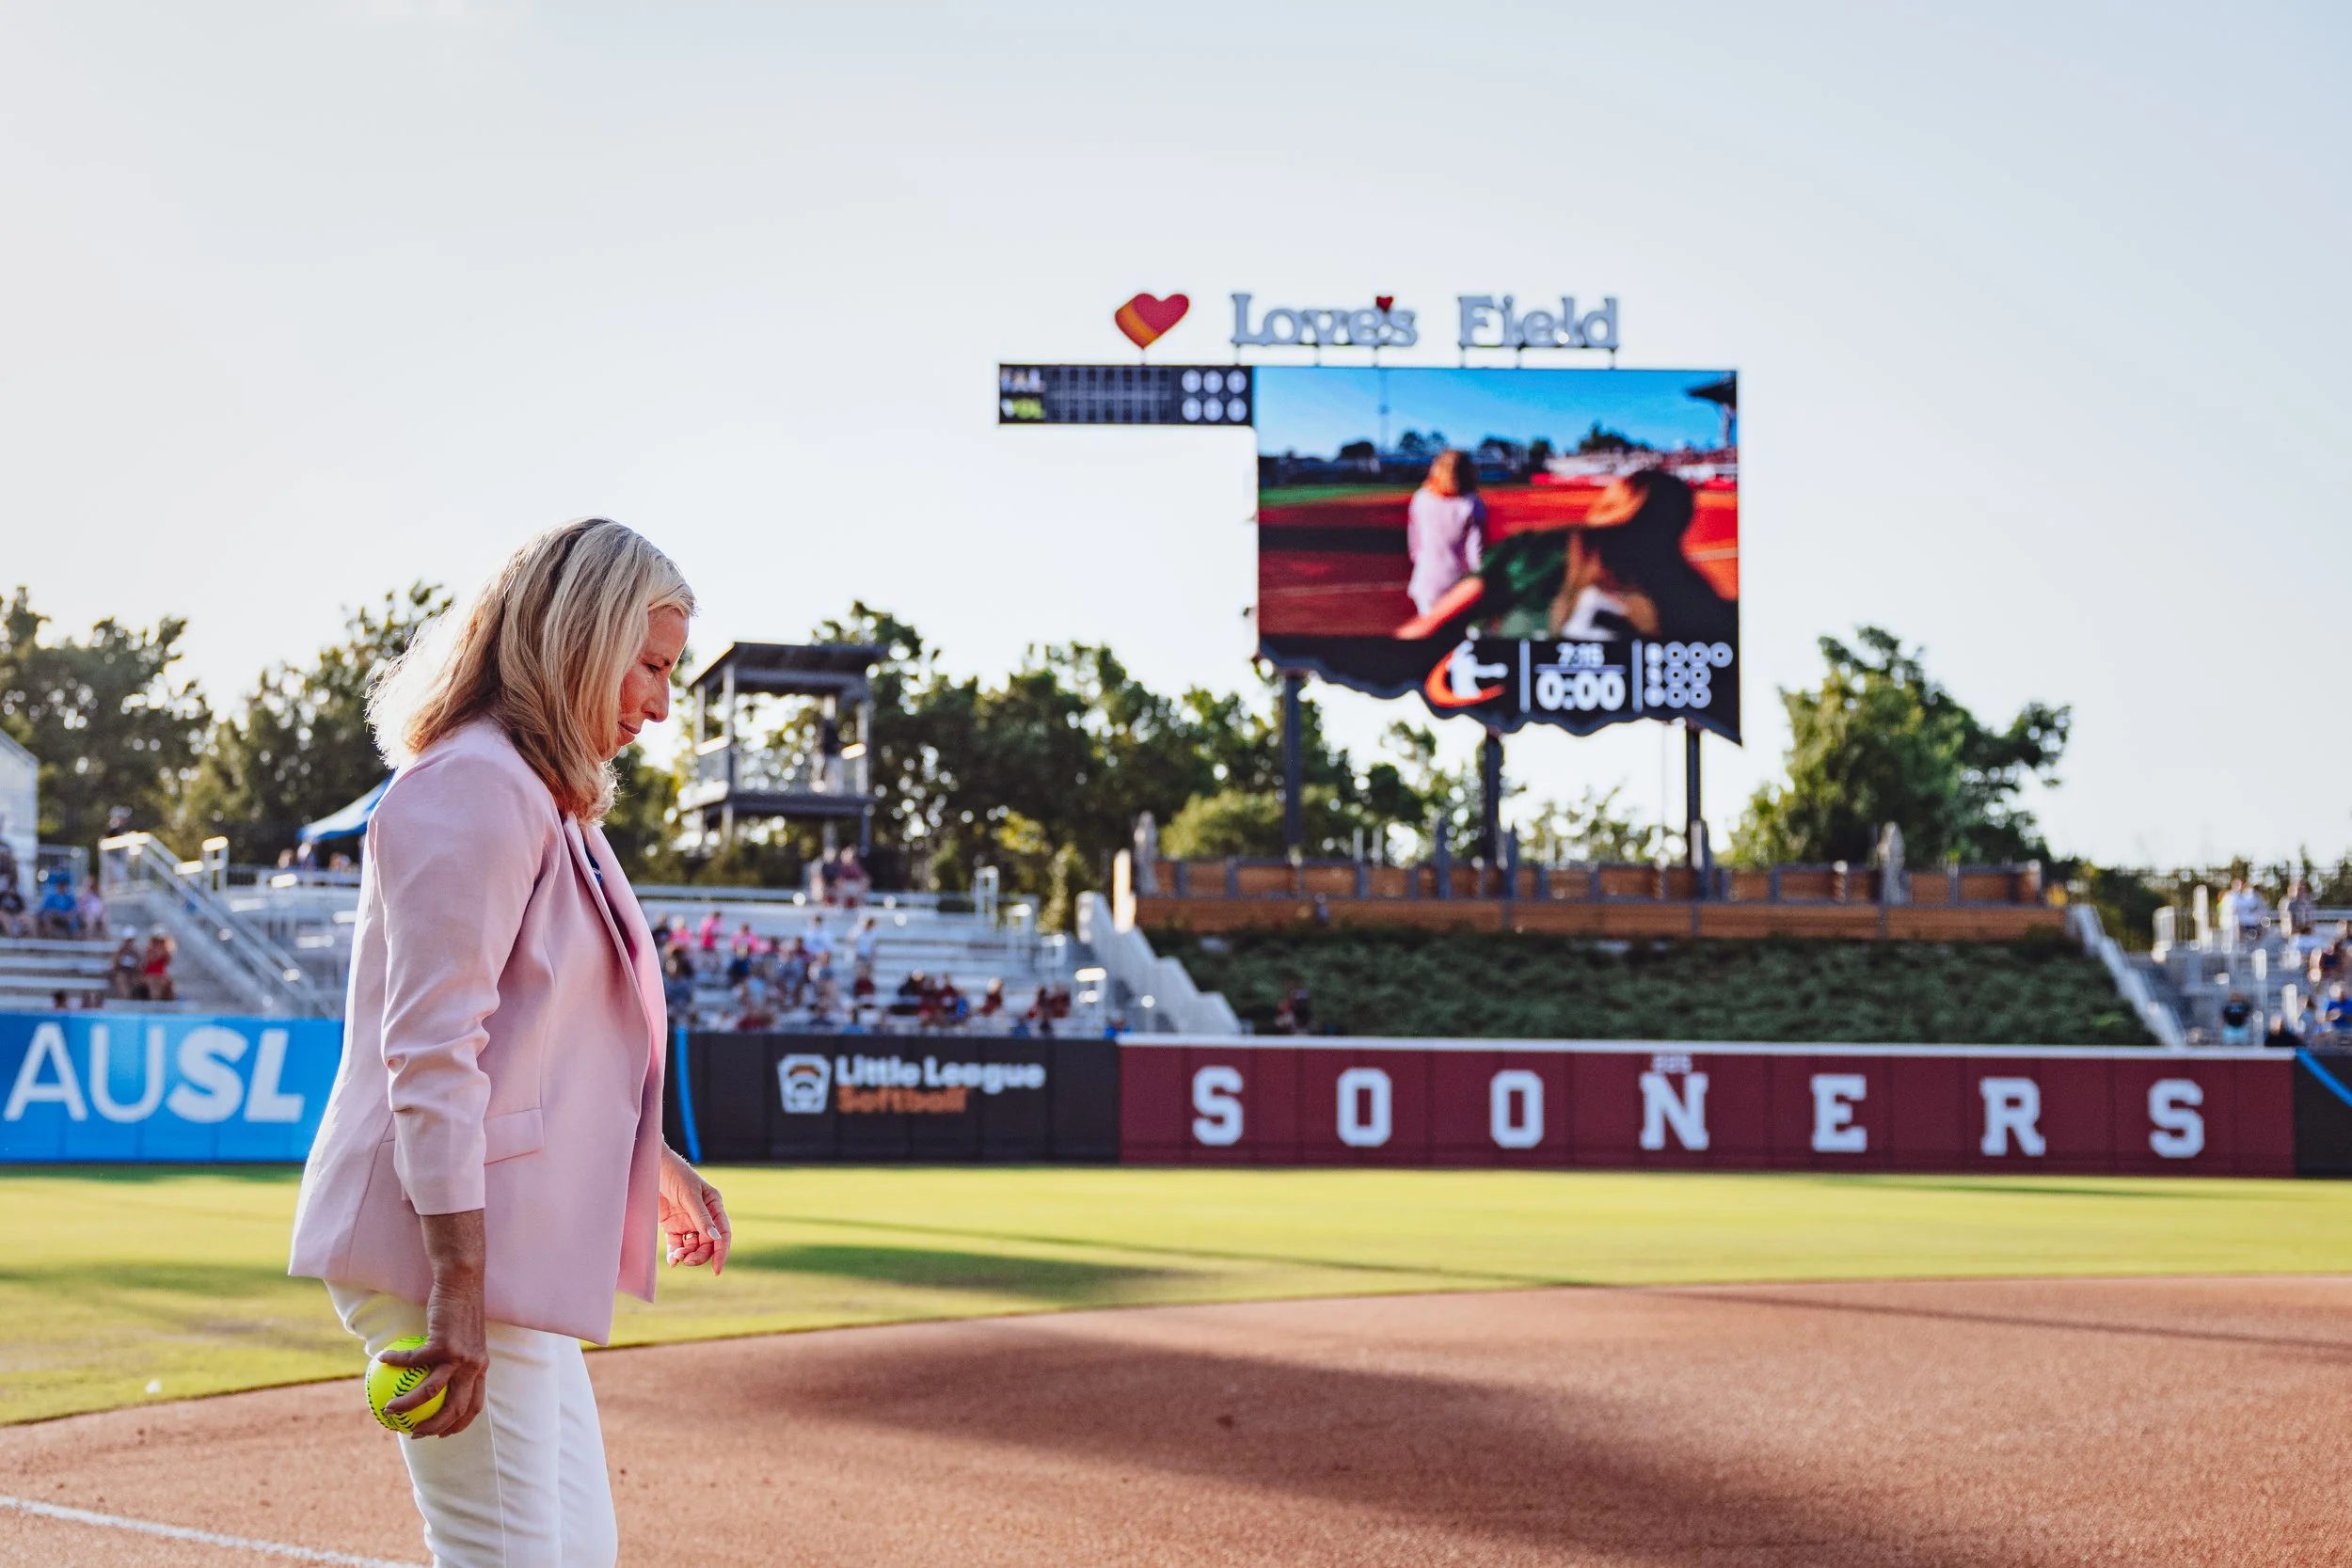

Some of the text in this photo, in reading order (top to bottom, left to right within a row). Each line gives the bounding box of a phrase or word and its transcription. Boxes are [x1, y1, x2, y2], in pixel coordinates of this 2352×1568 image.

[1231, 293, 1618, 348] Love's Field
[1535, 669, 1626, 711] 0:00
[3, 1022, 305, 1123] AUSL
[835, 1054, 1046, 1095] Little League
[836, 1085, 967, 1113] Softball
[1192, 1066, 2204, 1158] SOONERS
